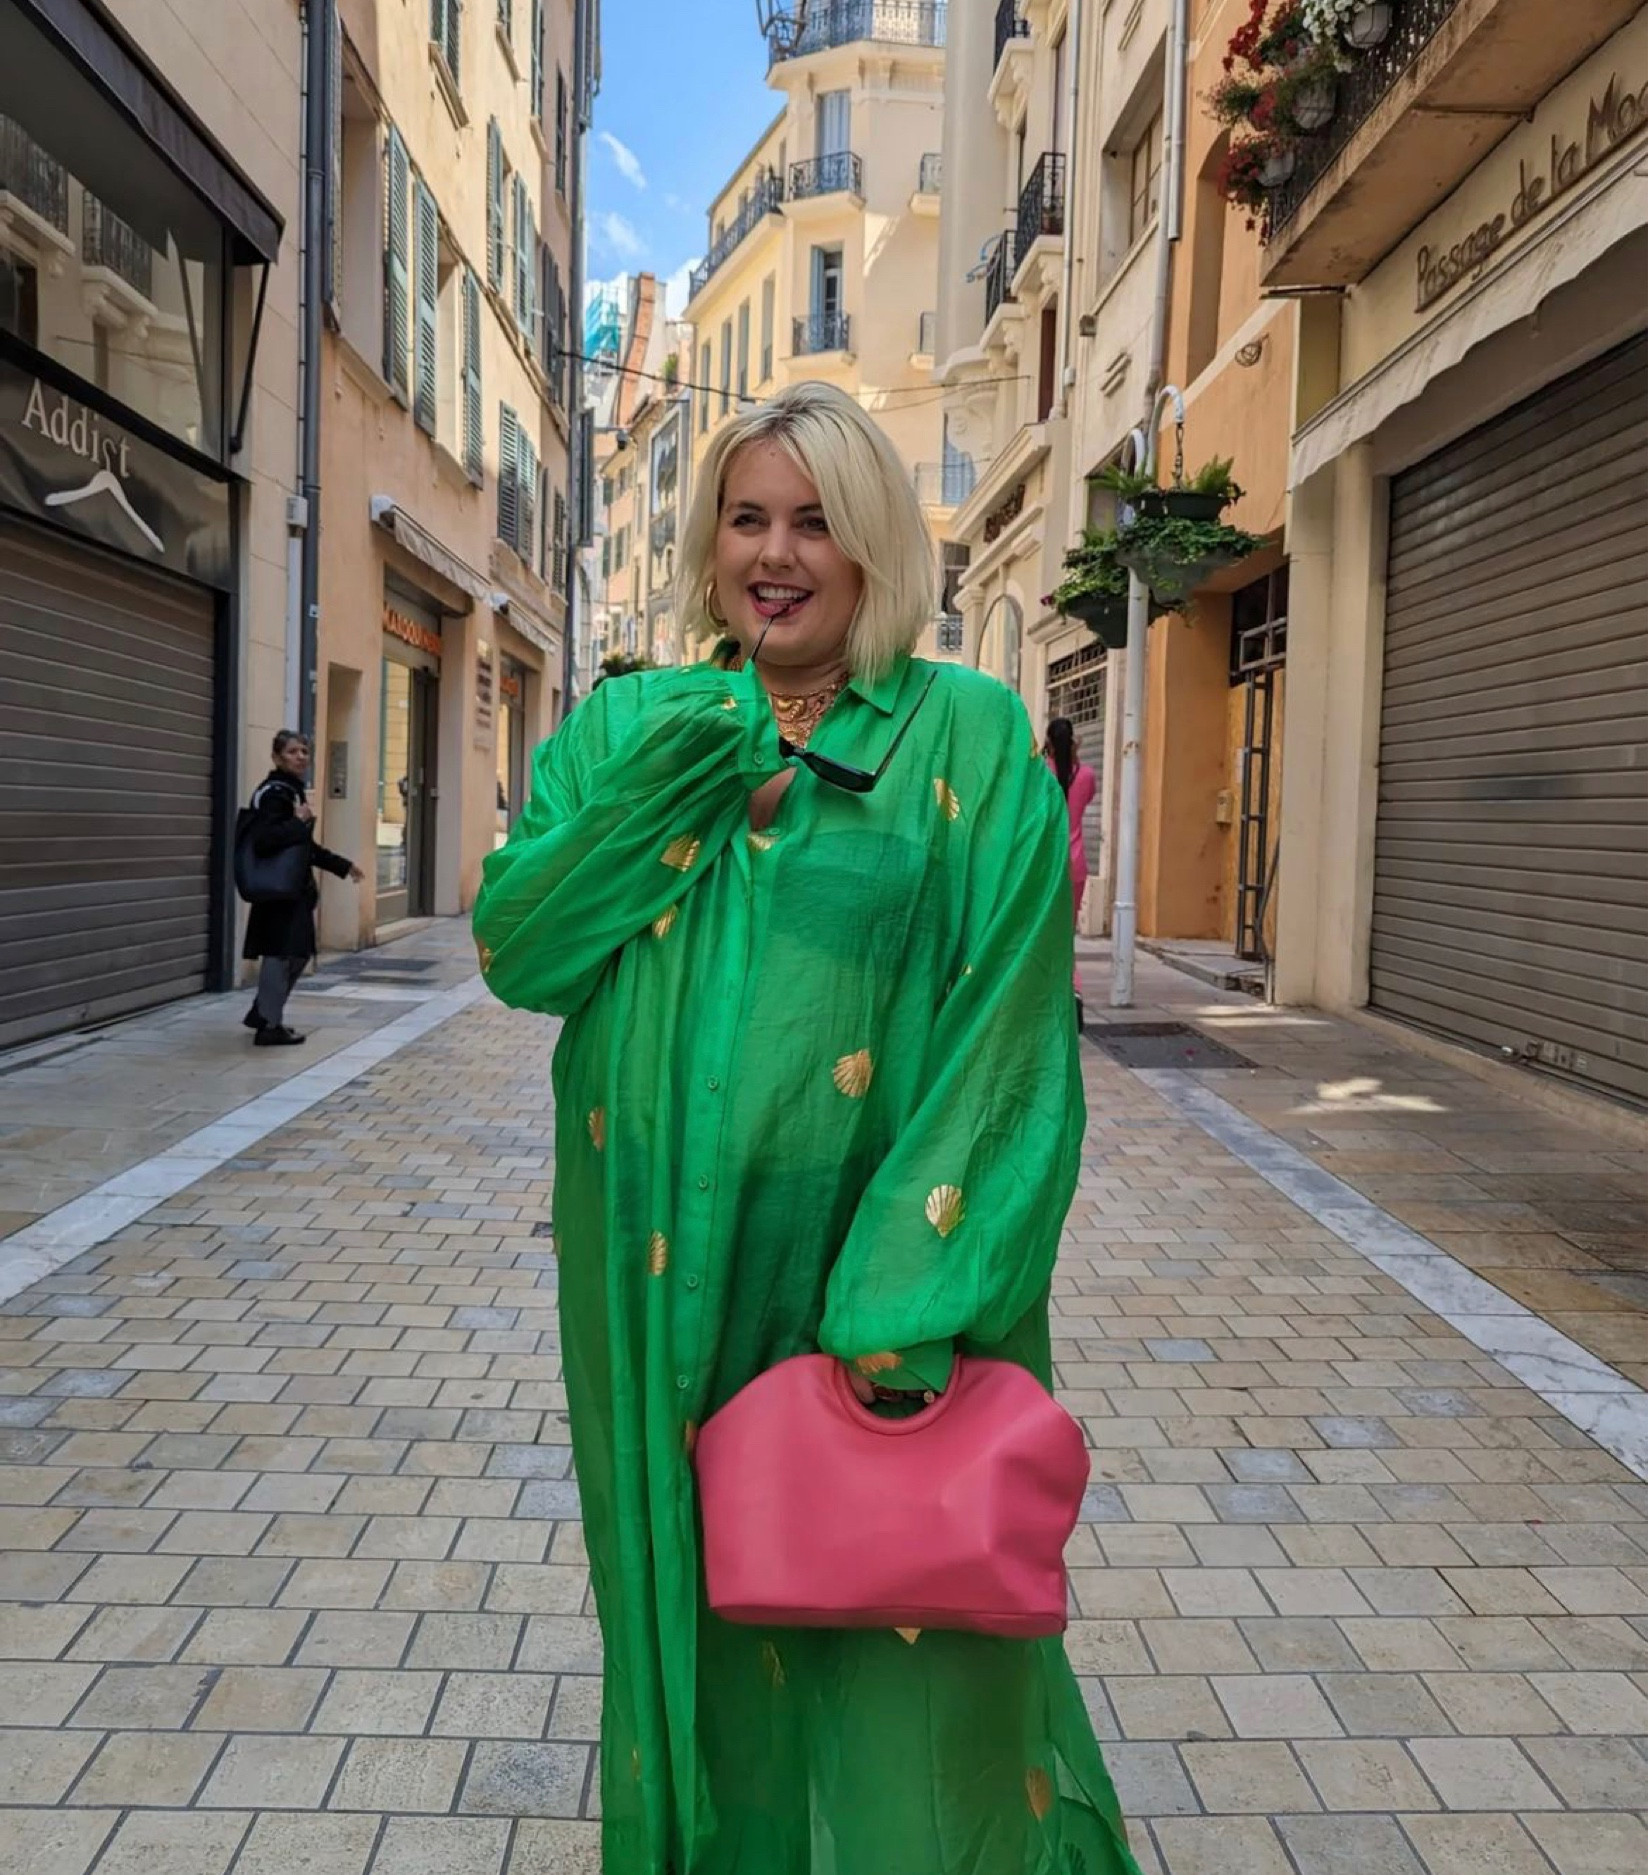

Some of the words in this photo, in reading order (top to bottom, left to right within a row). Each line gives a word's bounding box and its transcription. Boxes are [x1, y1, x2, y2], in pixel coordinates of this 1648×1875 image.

[1416, 212, 1506, 308] Passage
[1511, 158, 1545, 227] de
[1551, 134, 1580, 198] la
